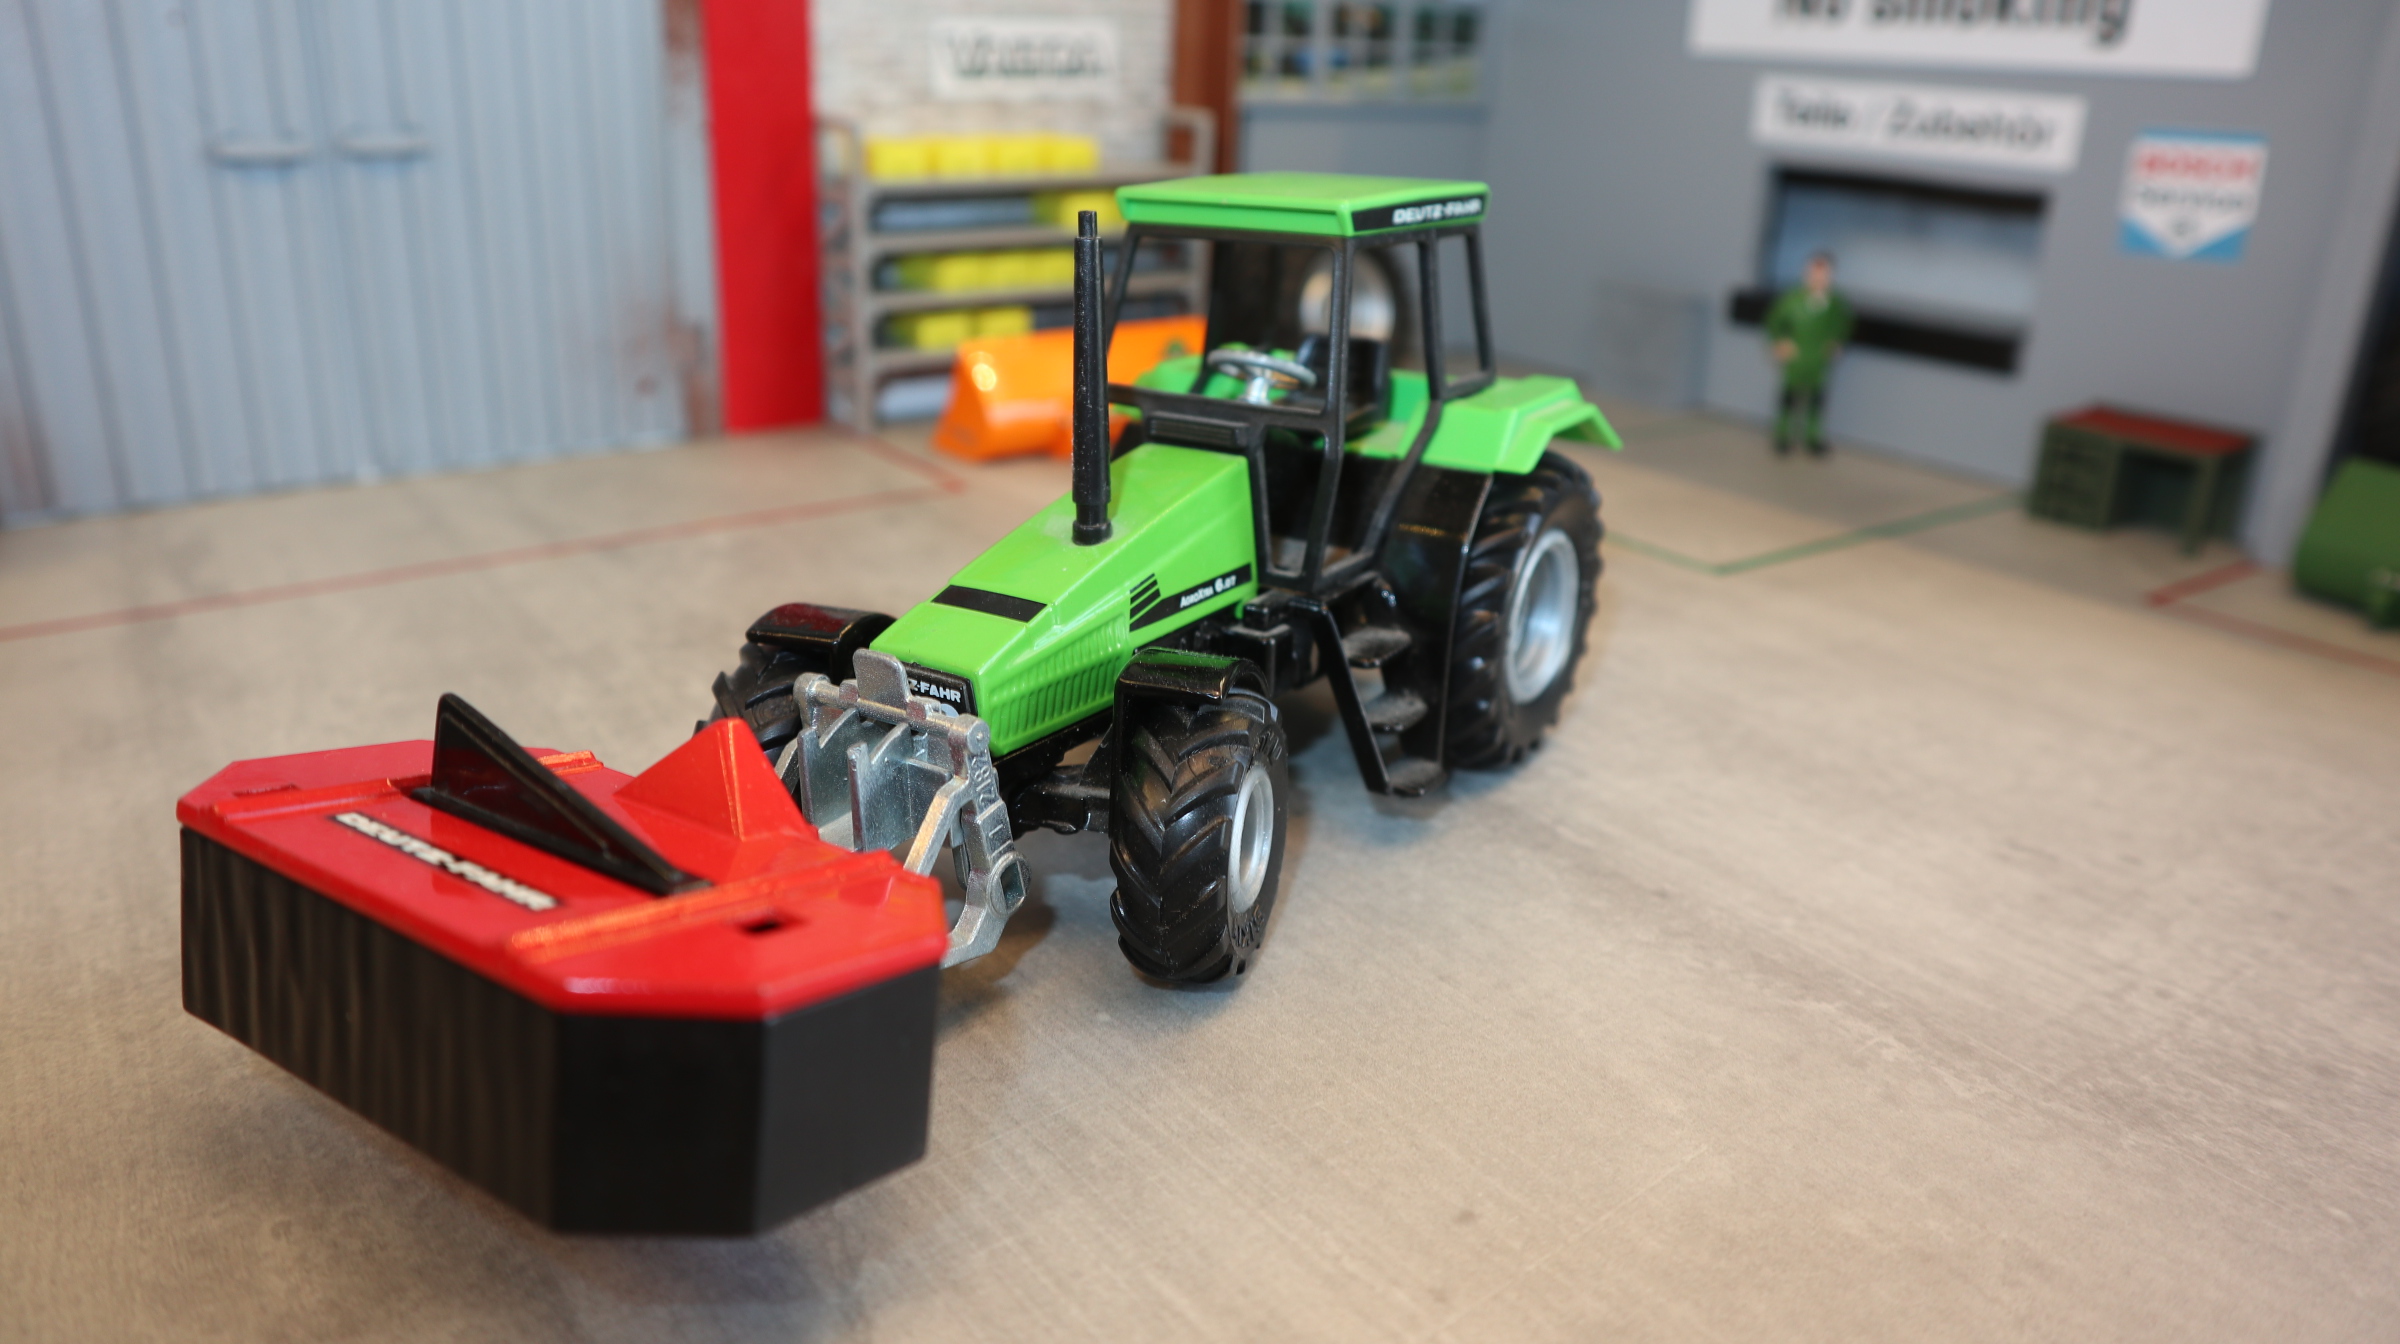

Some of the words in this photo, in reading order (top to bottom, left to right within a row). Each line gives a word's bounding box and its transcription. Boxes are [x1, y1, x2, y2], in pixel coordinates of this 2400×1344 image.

[1393, 198, 1482, 225] DEUTZ-FAHR
[908, 679, 961, 702] Z-FAHR
[336, 812, 557, 911] DEUTZ-FAHR
